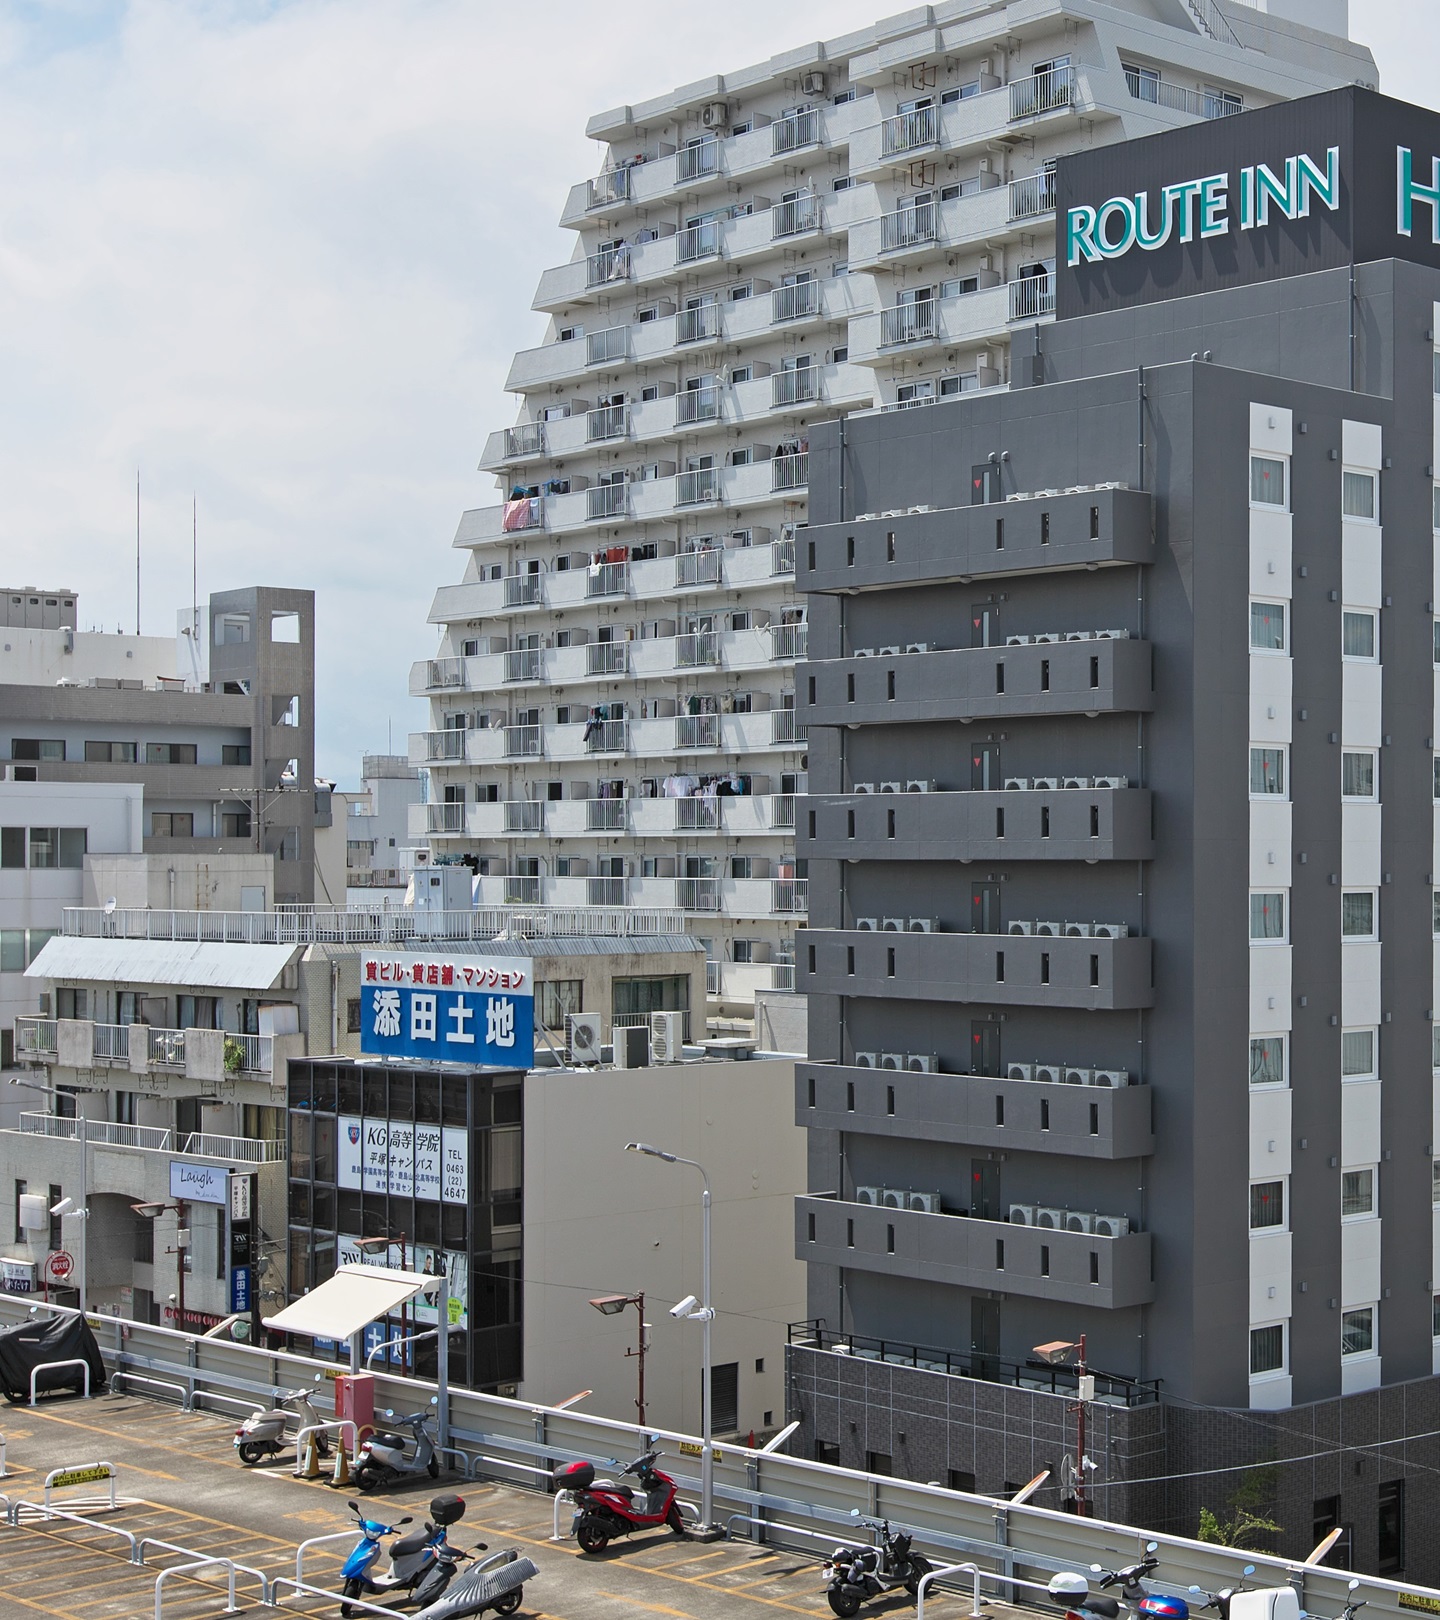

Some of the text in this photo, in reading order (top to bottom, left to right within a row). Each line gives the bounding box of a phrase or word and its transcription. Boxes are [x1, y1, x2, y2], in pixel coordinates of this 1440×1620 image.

[1068, 146, 1339, 267] ROUTE INN
[365, 961, 524, 989] 貸ビル・貸店舗・マンション
[372, 989, 515, 1047] 添田土地
[367, 1127, 440, 1152] KG高等学院
[369, 1152, 433, 1171] 平塚キャンパス
[448, 1149, 462, 1160] TEL
[446, 1163, 464, 1174] 0463
[448, 1176, 463, 1187] (22)
[444, 1187, 466, 1199] 4647
[236, 1270, 246, 1310] 添田土地
